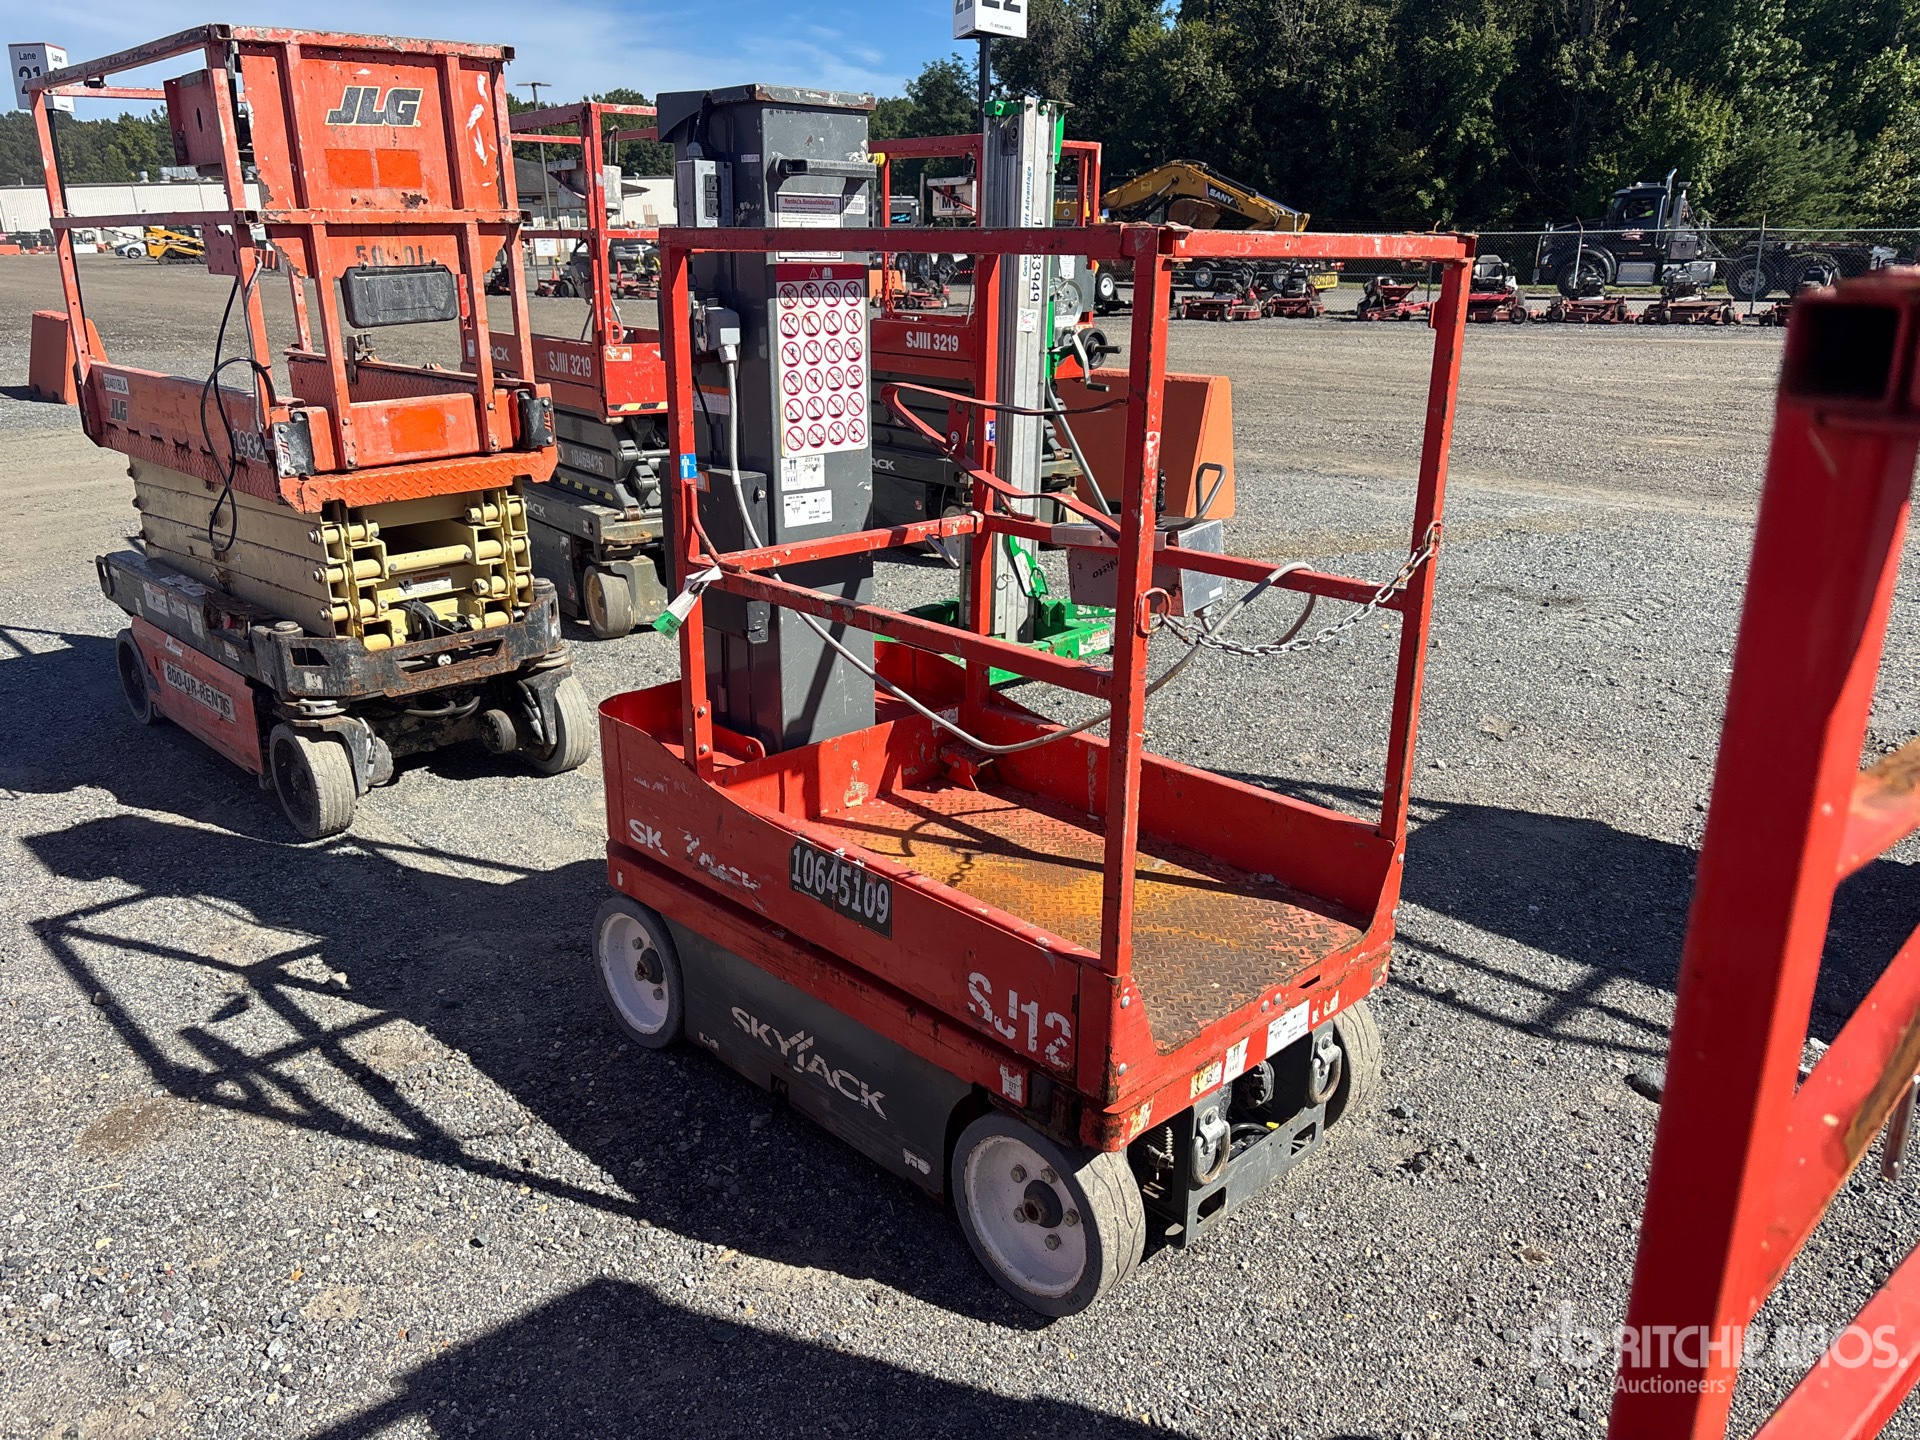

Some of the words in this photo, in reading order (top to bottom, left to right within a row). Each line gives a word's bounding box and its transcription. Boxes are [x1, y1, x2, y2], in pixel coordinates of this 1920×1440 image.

[18, 51, 37, 61] Lane
[51, 52, 63, 64] Lane
[325, 86, 423, 127] JLG
[1208, 188, 1234, 205] SANY
[906, 331, 931, 350] SJIII
[933, 333, 959, 352] 3219
[570, 354, 591, 378] 3219
[110, 398, 128, 423] JLG
[791, 845, 889, 924] 10645109
[967, 972, 1072, 1069] SJ12
[731, 1006, 888, 1120] SKYJACK
